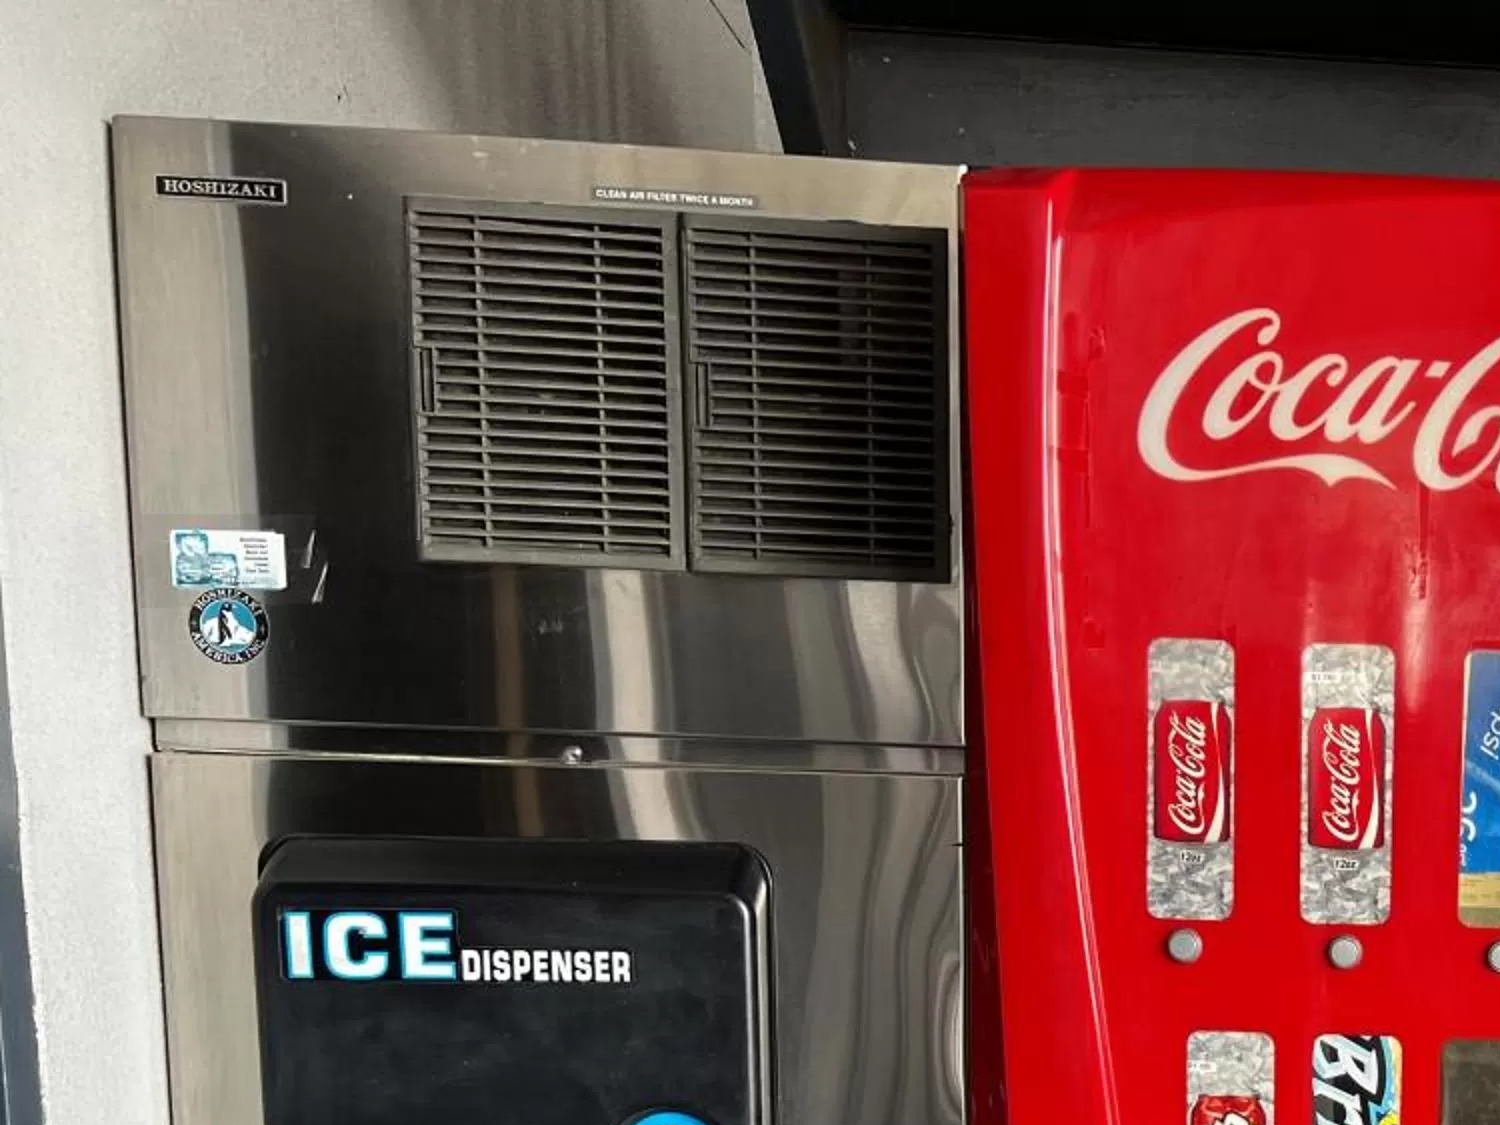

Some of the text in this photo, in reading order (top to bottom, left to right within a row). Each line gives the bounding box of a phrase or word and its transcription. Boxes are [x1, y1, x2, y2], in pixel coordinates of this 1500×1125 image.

[163, 179, 277, 198] HOSHIZAKI
[596, 189, 627, 199] CLEAN
[629, 191, 645, 200] AIR
[647, 192, 677, 202] FILTER
[195, 589, 263, 616] HOSHIZAKI
[283, 910, 631, 982] ICE DISPENSER
